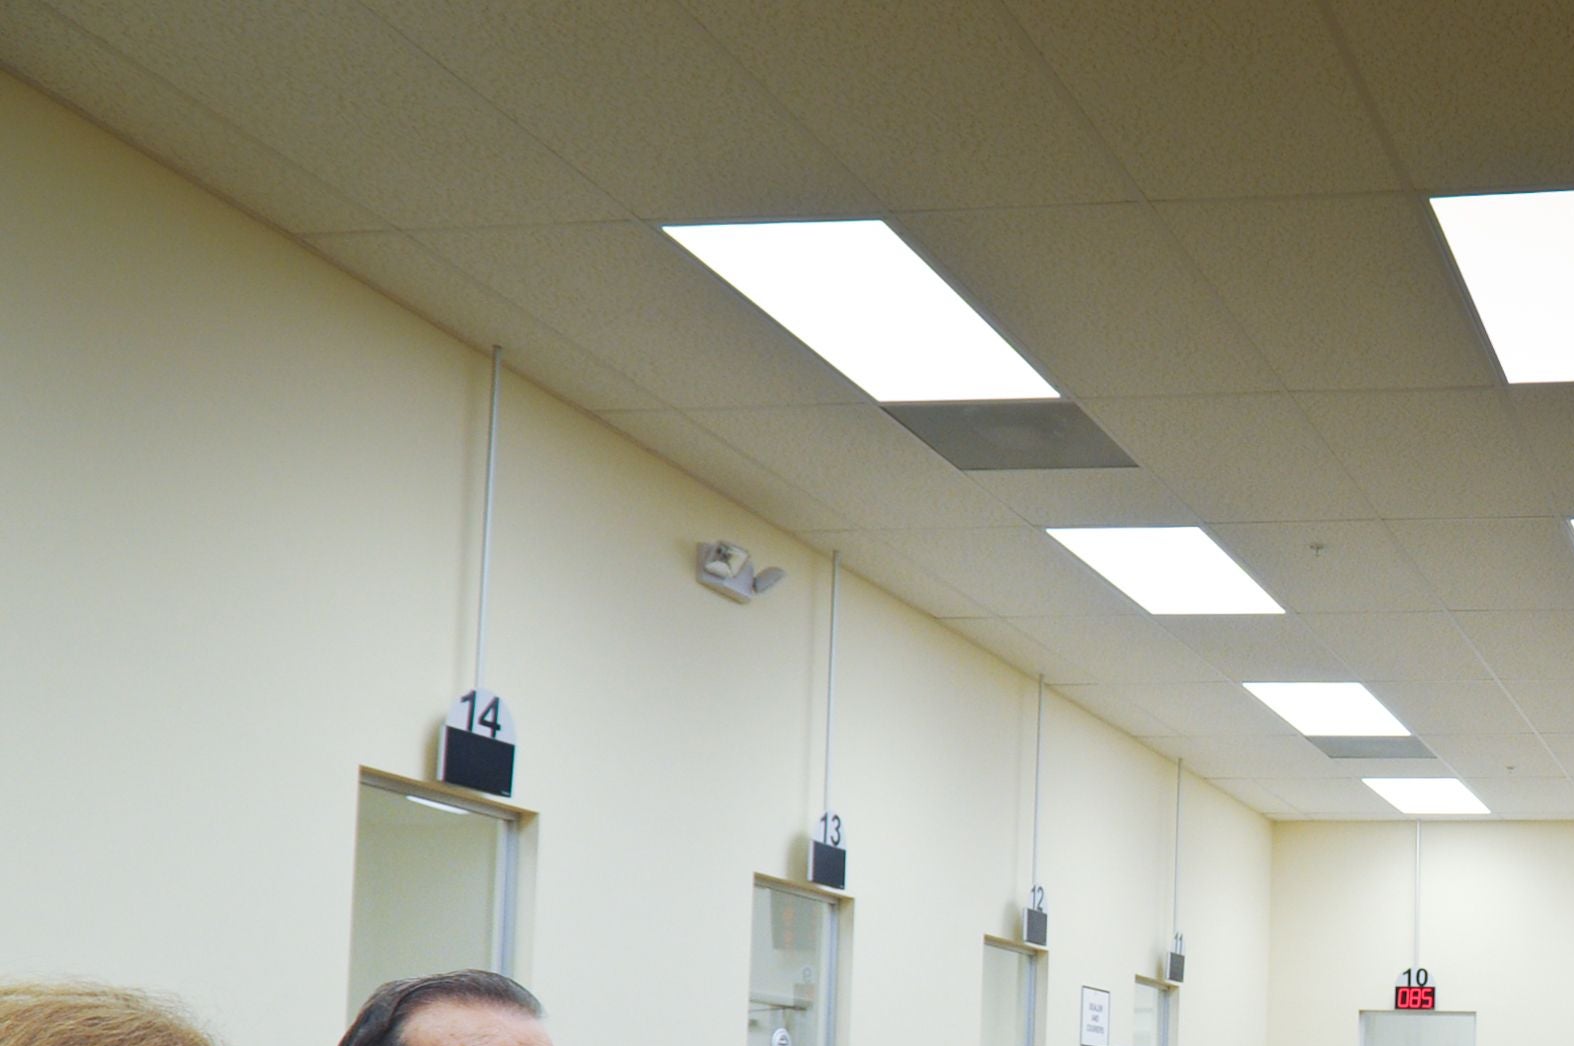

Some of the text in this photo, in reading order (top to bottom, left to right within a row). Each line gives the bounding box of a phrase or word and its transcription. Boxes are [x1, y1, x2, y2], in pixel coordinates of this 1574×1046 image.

[460, 689, 501, 738] 14
[820, 812, 842, 847] 13
[1031, 885, 1044, 912] 12
[1402, 968, 1429, 987] 10
[1397, 987, 1433, 1009] 085
